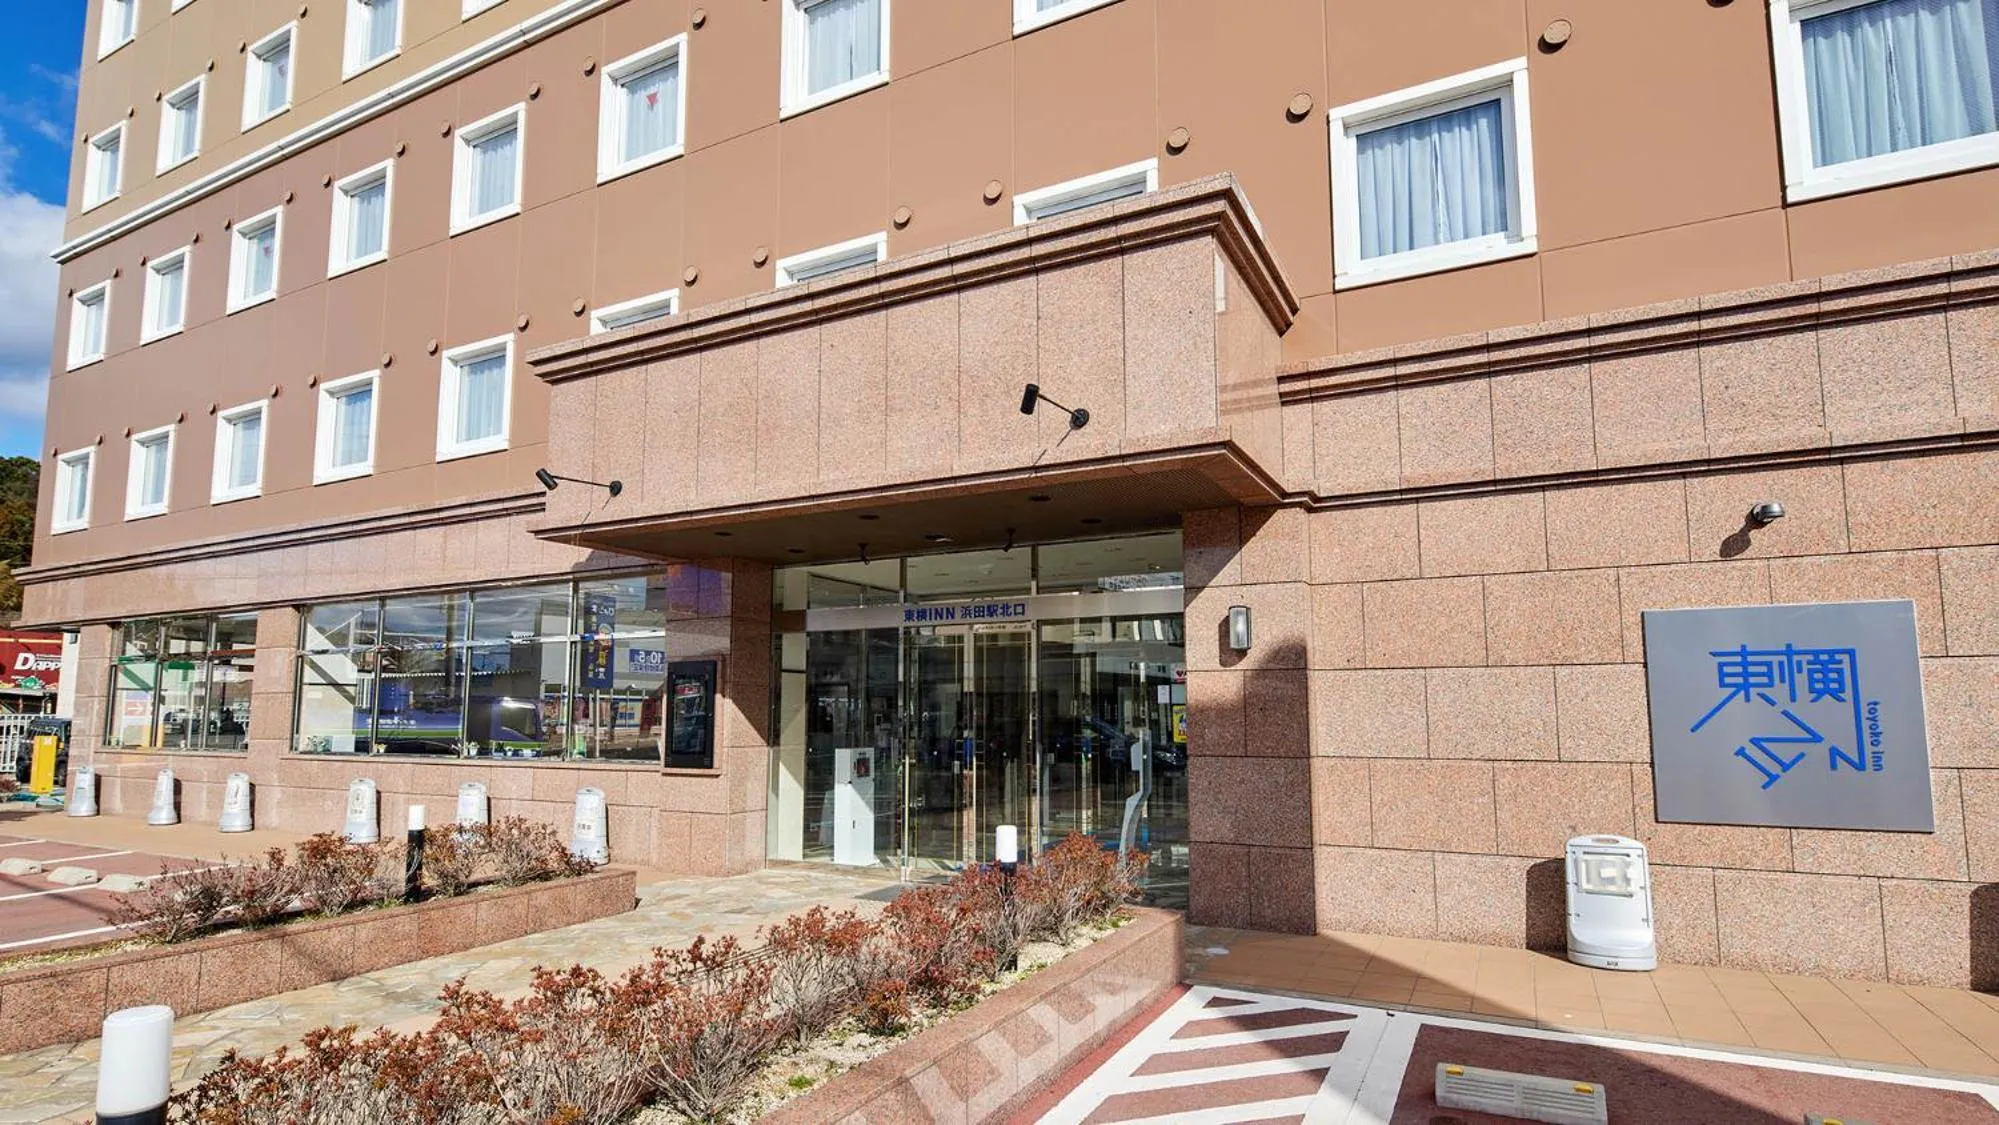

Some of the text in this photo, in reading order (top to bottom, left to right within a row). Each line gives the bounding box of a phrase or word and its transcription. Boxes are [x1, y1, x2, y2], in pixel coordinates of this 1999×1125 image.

[904, 603, 1026, 622] 東横INN 浜田駅北口
[1866, 701, 1884, 772] toyoko inn
